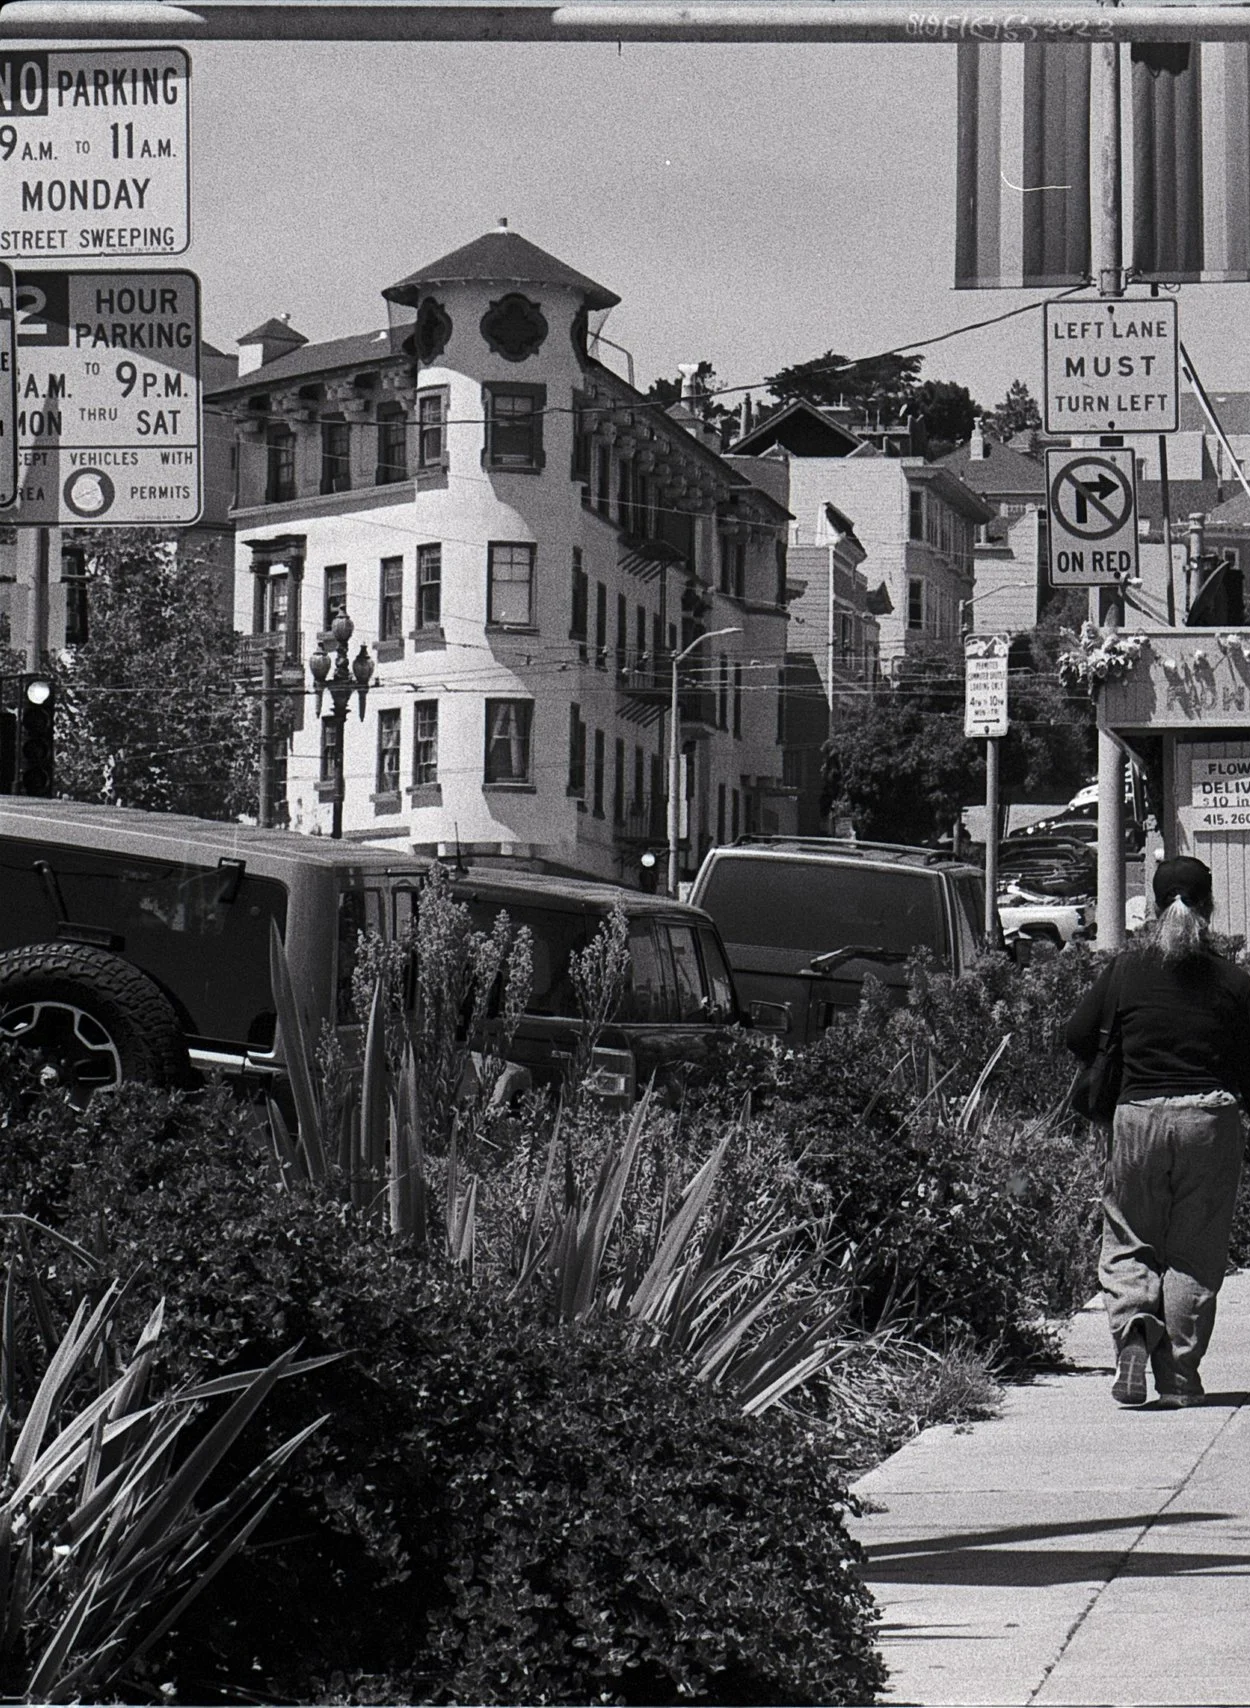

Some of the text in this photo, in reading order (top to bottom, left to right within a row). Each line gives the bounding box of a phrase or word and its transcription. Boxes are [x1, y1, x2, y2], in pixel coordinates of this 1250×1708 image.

[57, 67, 178, 107] PARKING
[0, 122, 177, 161] 9 A.M. TO 11 A.M.
[21, 178, 151, 211] MONDAY
[0, 227, 175, 250] STREET SWEEPING
[16, 284, 178, 335] 2 HOUR
[75, 323, 192, 349] PARKING
[1054, 321, 1167, 339] LEFT LANE
[1065, 356, 1155, 378] MUST
[24, 373, 73, 399] A.M.
[85, 362, 100, 376] TO
[116, 361, 137, 398] 9
[143, 374, 188, 398] P.M.
[1055, 394, 1168, 412] TURN LEFT
[79, 408, 118, 422] THRU
[136, 410, 181, 436] SAT
[70, 452, 139, 466] VEHICLES
[160, 452, 193, 466] WITH
[130, 486, 191, 500] PERMITS
[1057, 551, 1131, 572] ON RED
[1236, 796, 1250, 807] in
